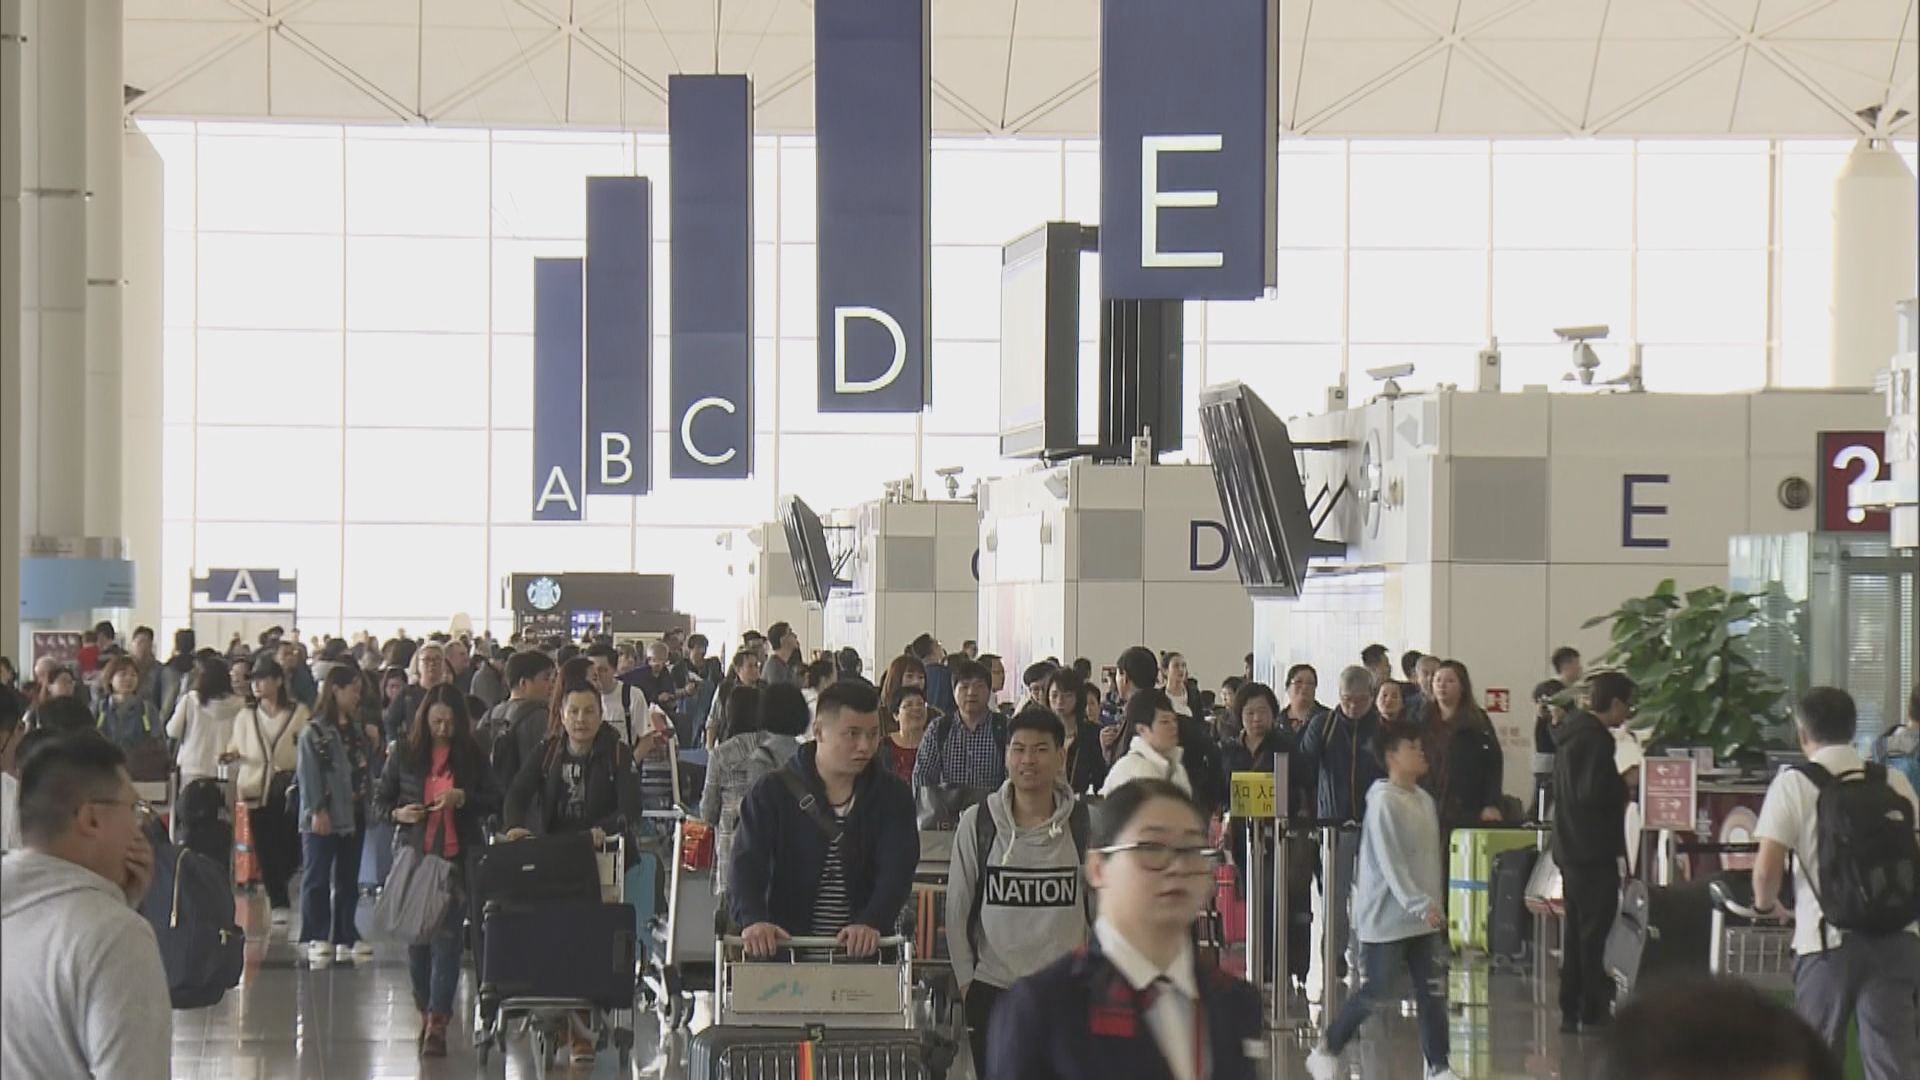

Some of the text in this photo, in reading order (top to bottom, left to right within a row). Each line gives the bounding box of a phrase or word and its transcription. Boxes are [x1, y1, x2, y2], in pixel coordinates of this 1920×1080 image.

[1141, 134, 1224, 268] E
[834, 306, 907, 393] D
[681, 396, 737, 465] C
[600, 431, 633, 485] B
[535, 465, 578, 512] A
[1621, 474, 1670, 548] E
[1189, 520, 1232, 571] D
[226, 569, 261, 602] A
[1263, 802, 1272, 812] In
[989, 873, 1075, 903] NATION
